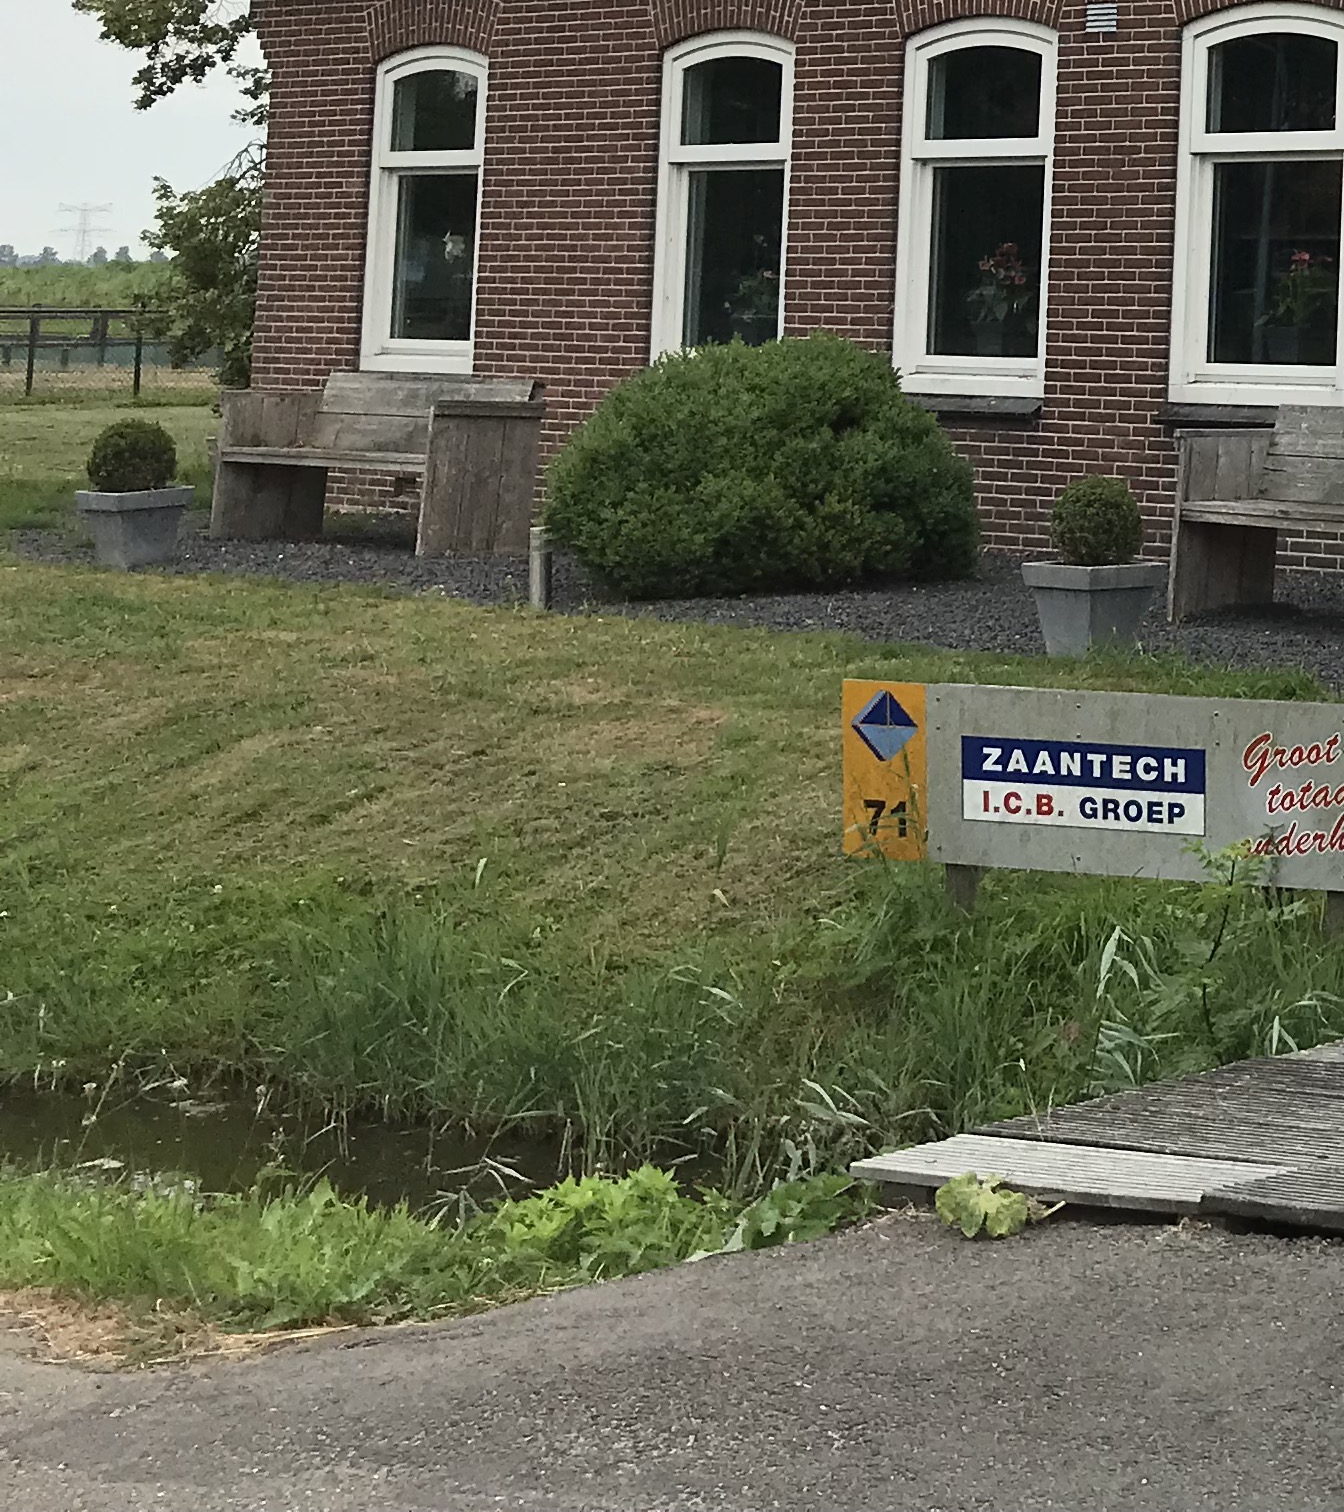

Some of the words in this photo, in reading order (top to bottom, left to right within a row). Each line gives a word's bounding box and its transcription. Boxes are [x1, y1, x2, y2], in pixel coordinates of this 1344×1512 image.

[982, 746, 1186, 783] ZAANTECH
[1242, 730, 1341, 789] Groot
[863, 799, 907, 838] 71
[982, 790, 1065, 817] I.C.B.
[1078, 796, 1186, 825] GROEP
